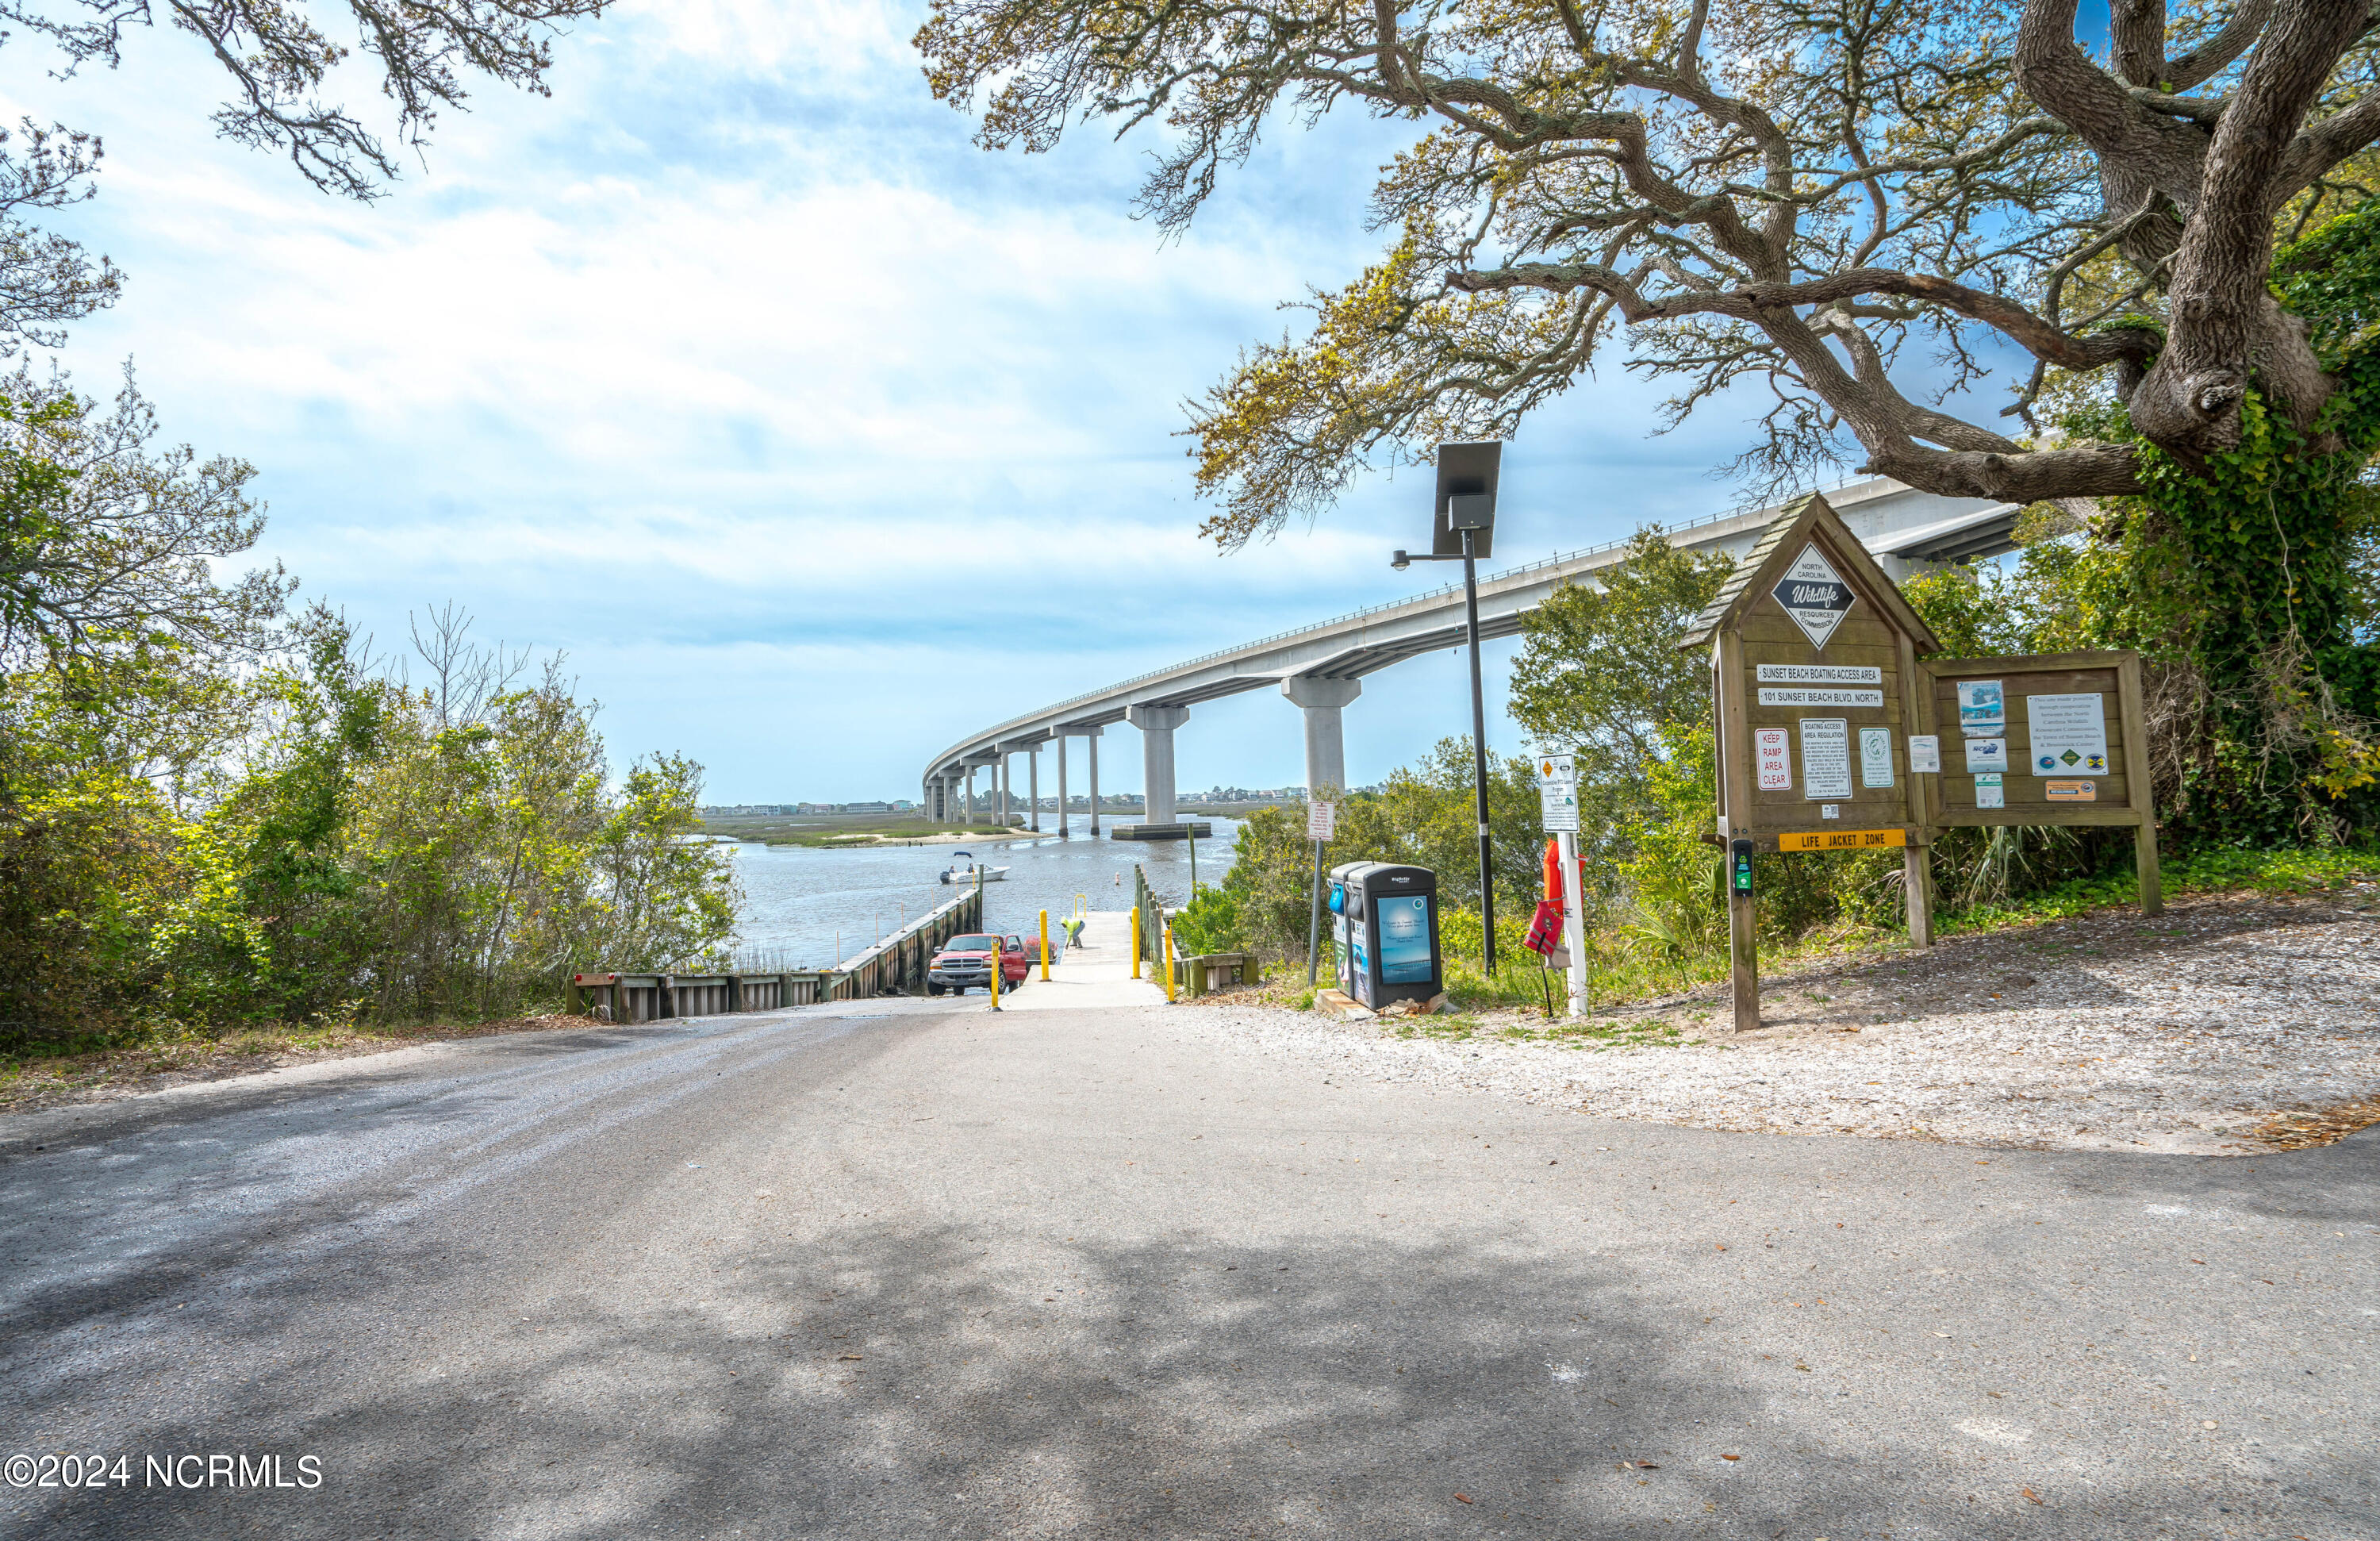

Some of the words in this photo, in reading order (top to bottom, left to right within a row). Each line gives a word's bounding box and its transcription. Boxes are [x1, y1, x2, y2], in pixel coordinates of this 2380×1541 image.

[1792, 585, 1839, 609] Wildlife
[1801, 617, 1833, 628] COMMISSION
[1763, 667, 1787, 678] SUNSET
[1788, 668, 1809, 679] BEACH
[1810, 668, 1836, 680] BOATING
[1837, 669, 1860, 680] ACCESS
[1861, 670, 1876, 680] AREA
[1764, 692, 1775, 701] 101
[1778, 692, 1806, 701] SUNSET
[1808, 693, 1832, 701] BEACH
[1855, 694, 1879, 702] NORTH
[1763, 748, 1782, 757] RAMP
[1764, 762, 1783, 770] AREA
[1764, 774, 1786, 784] CLEAR
[1802, 836, 1820, 847] LIFE
[1829, 834, 1857, 847] JACKET
[1865, 833, 1885, 845] ZONE
